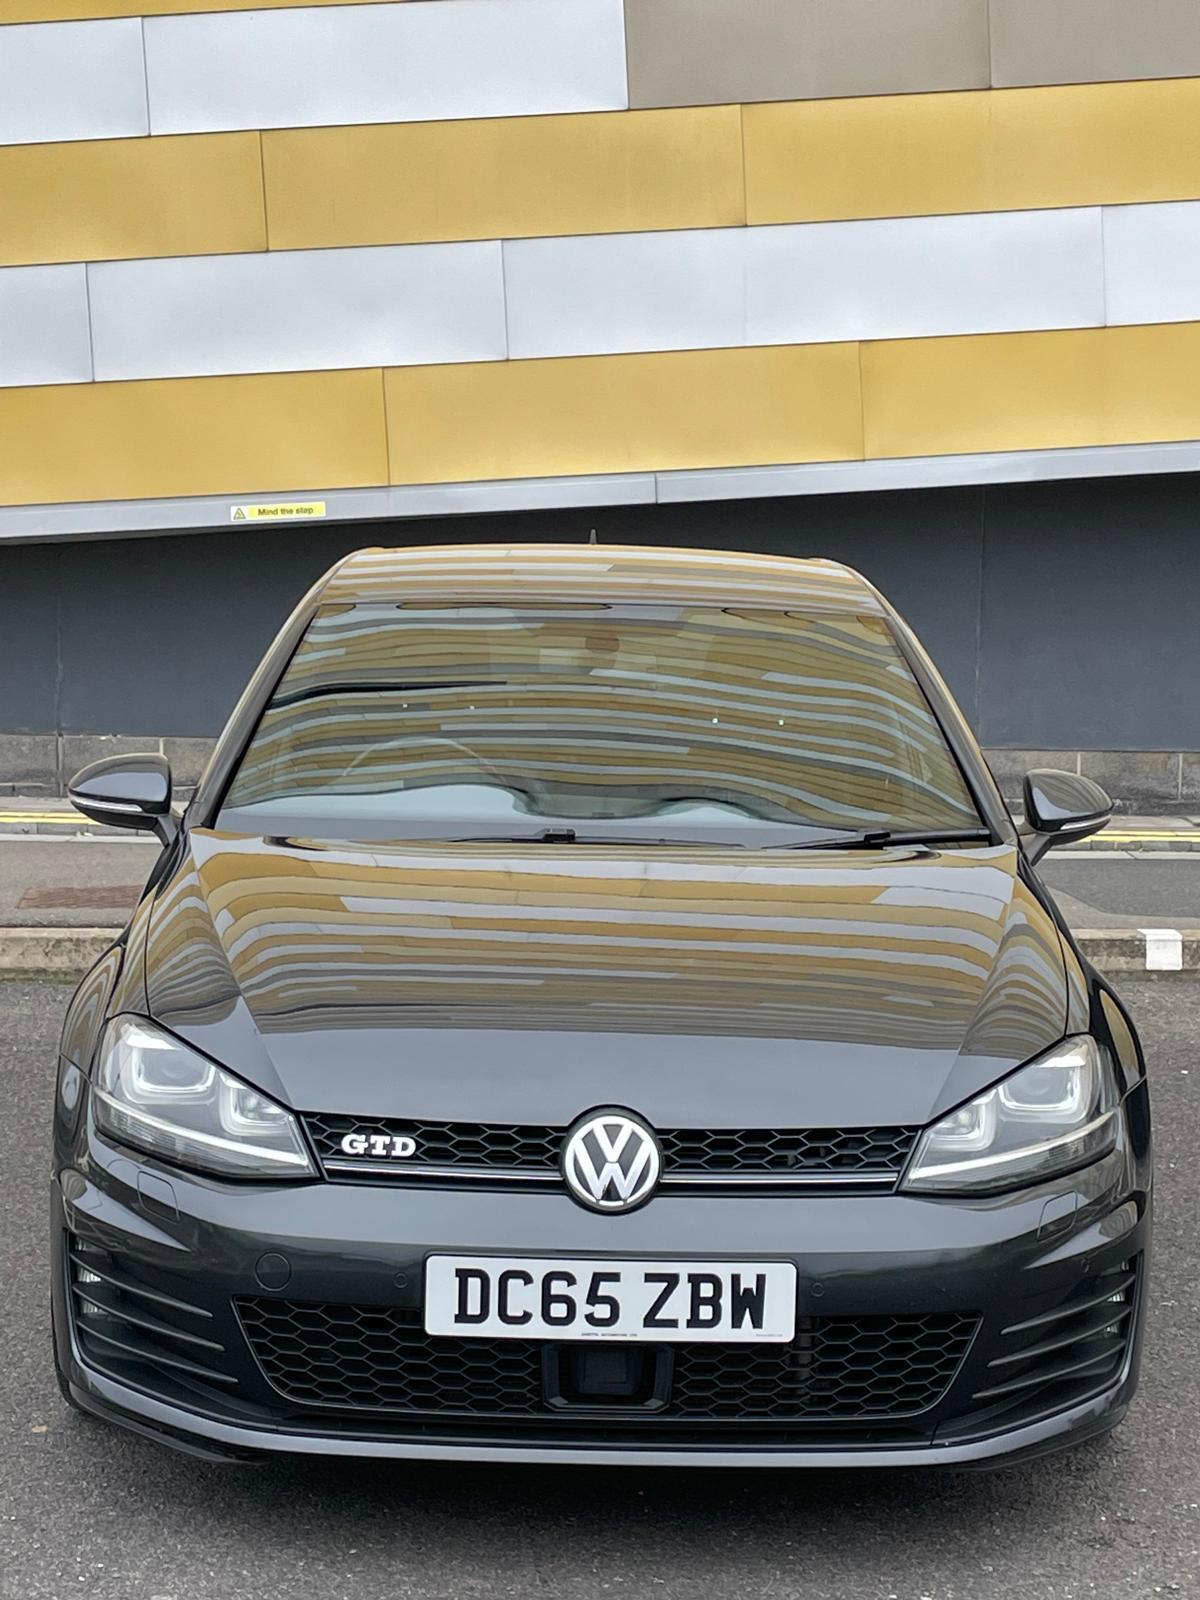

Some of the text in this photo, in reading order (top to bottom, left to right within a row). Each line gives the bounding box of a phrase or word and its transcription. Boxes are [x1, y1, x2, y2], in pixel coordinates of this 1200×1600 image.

[257, 508, 278, 516] Mind
[295, 506, 314, 515] step
[341, 1134, 416, 1157] GTD
[568, 1116, 657, 1204] VW
[454, 1268, 766, 1330] DC65 ZBW
